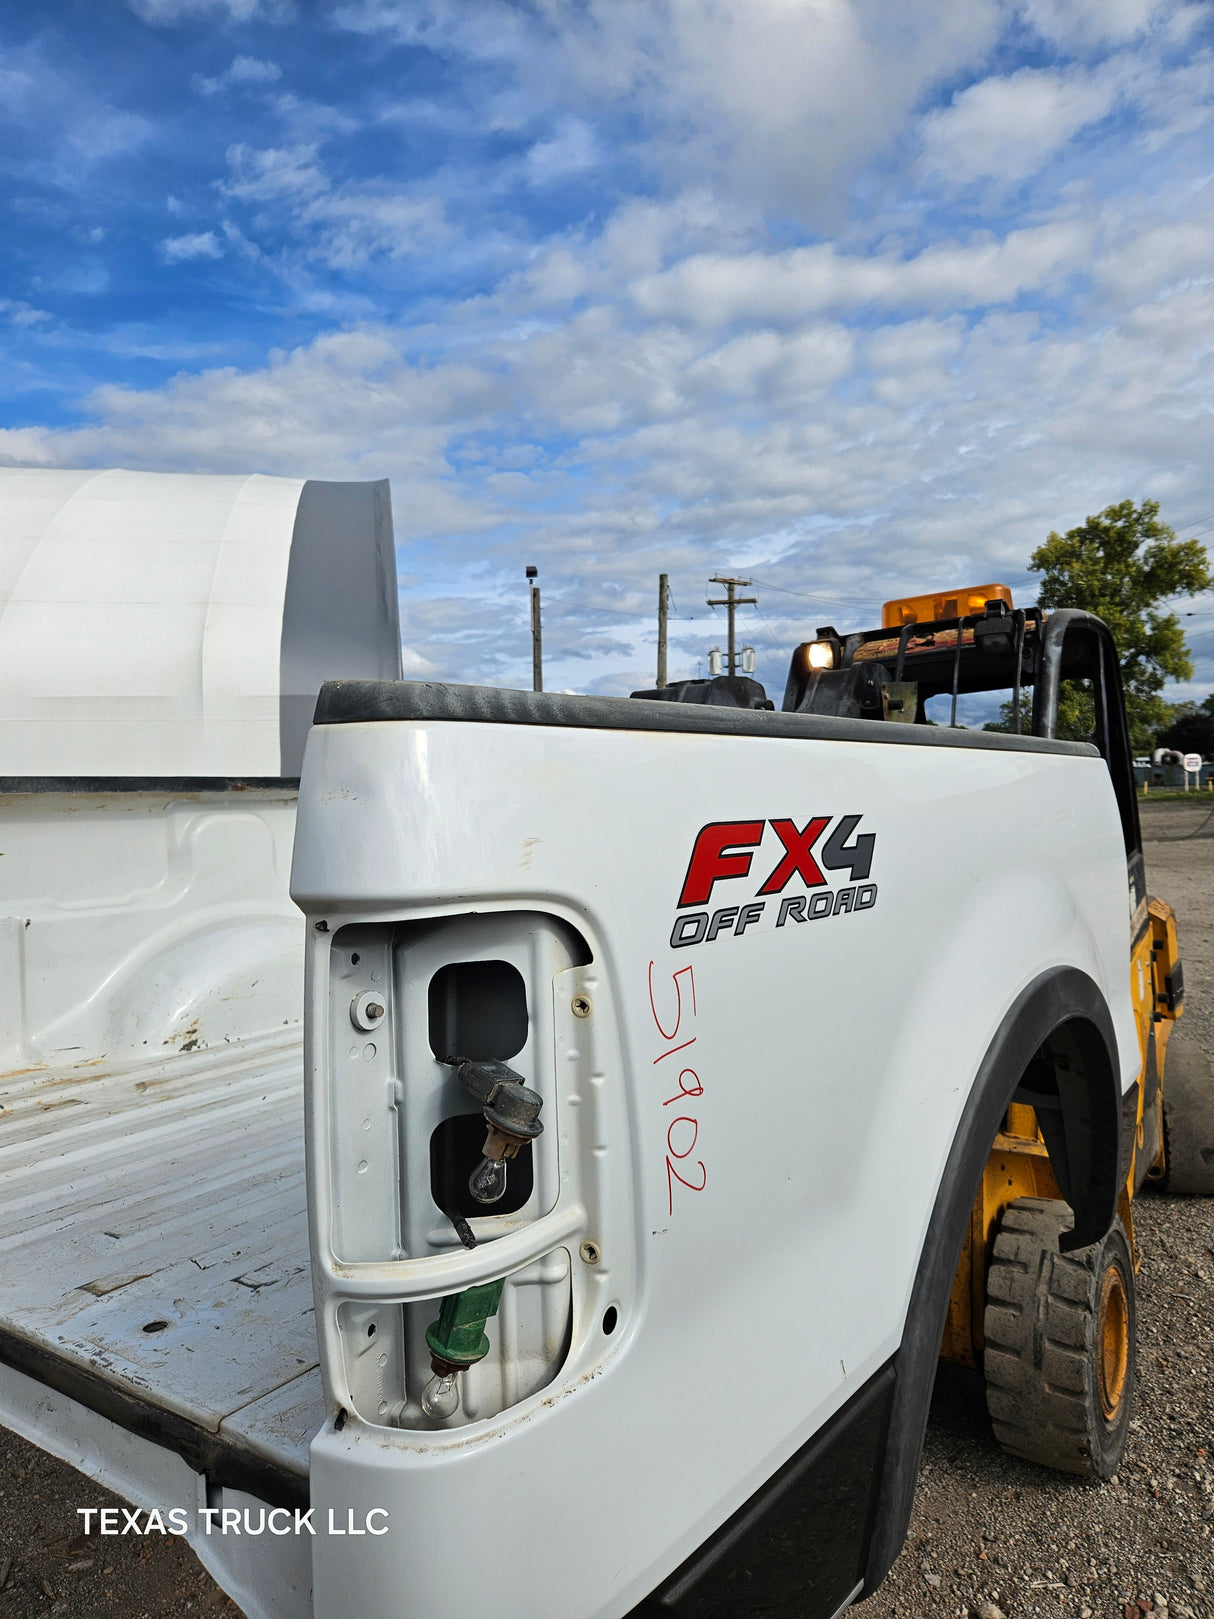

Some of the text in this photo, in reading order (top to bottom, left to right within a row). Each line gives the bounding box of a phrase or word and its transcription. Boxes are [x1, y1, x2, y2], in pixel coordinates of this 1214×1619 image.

[676, 814, 876, 909] FX4
[670, 884, 878, 948] OFF ROAD
[649, 960, 706, 1216] 51902
